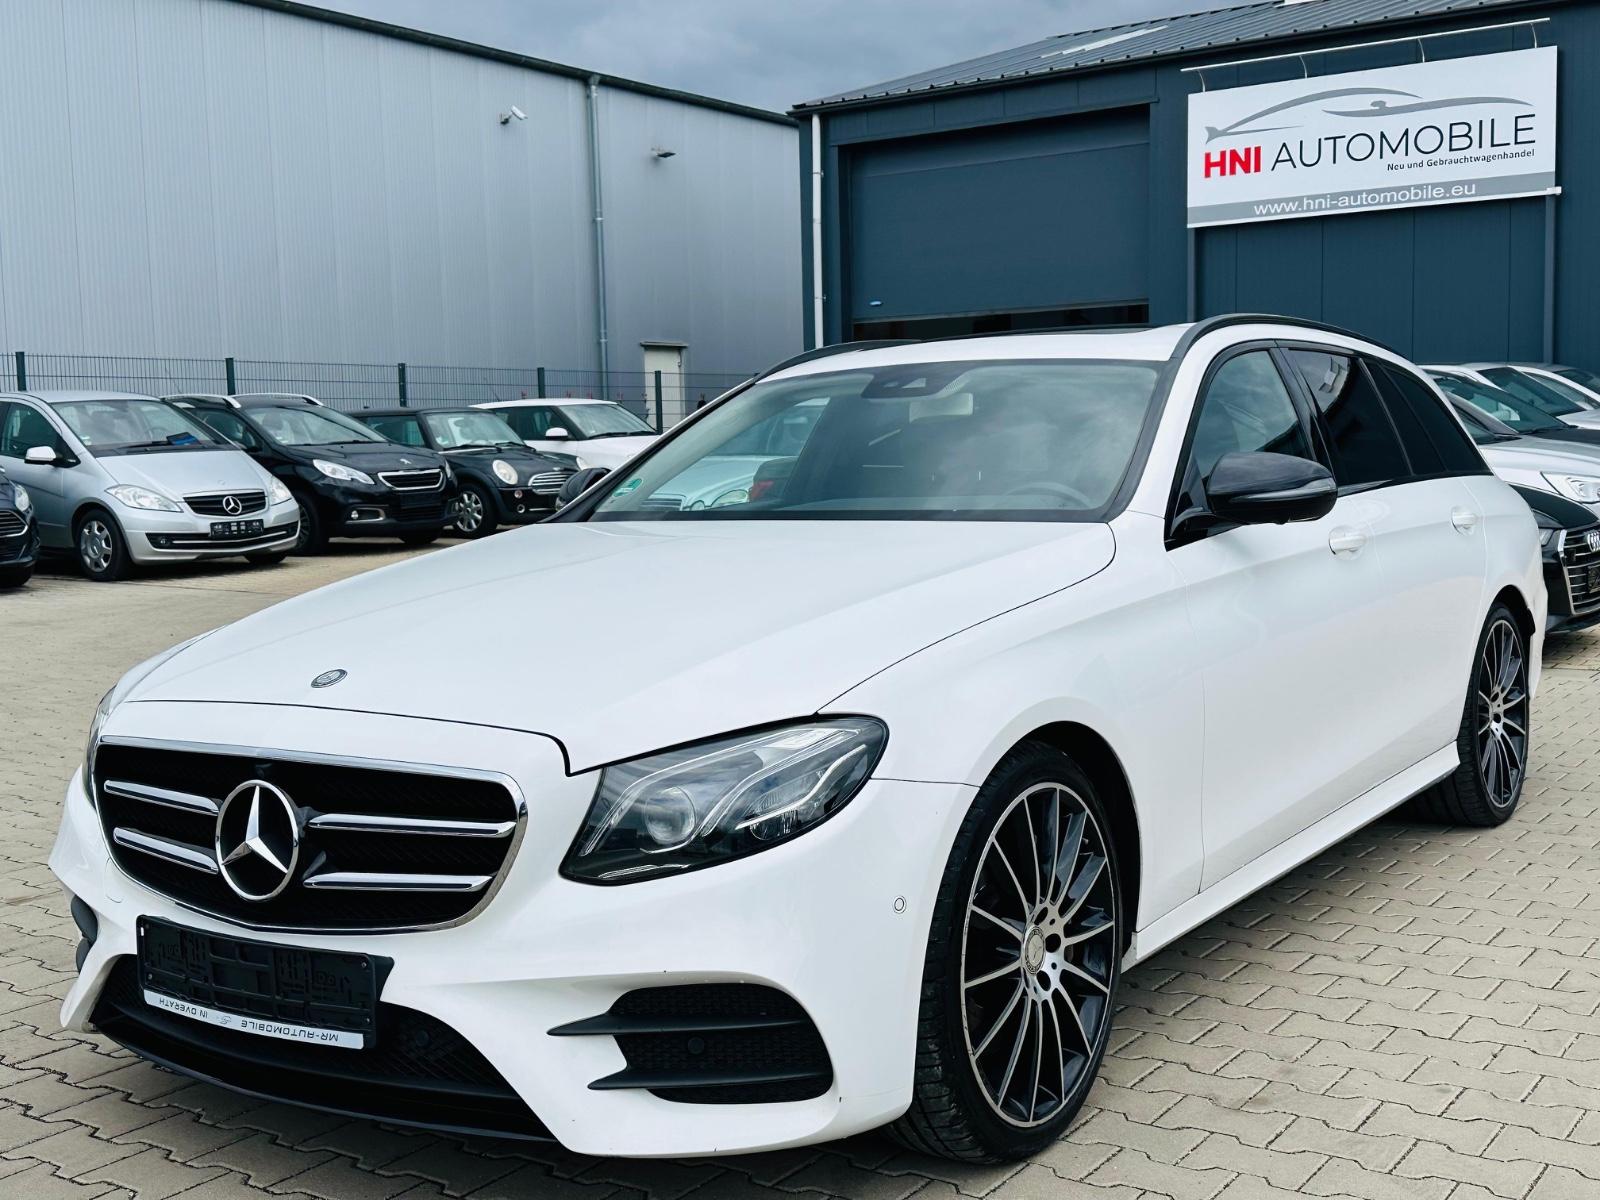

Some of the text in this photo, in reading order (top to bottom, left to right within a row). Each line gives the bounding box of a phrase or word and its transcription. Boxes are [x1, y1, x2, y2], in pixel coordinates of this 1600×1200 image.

[1204, 113, 1536, 178] HNI AUTOMOBILE
[1387, 149, 1535, 171] Neu und Gebrauchtwagenhandel
[1253, 182, 1476, 216] www.hni-automobile.eu
[159, 999, 339, 1042] MR-AUTOMOBILE IN OVERATH
